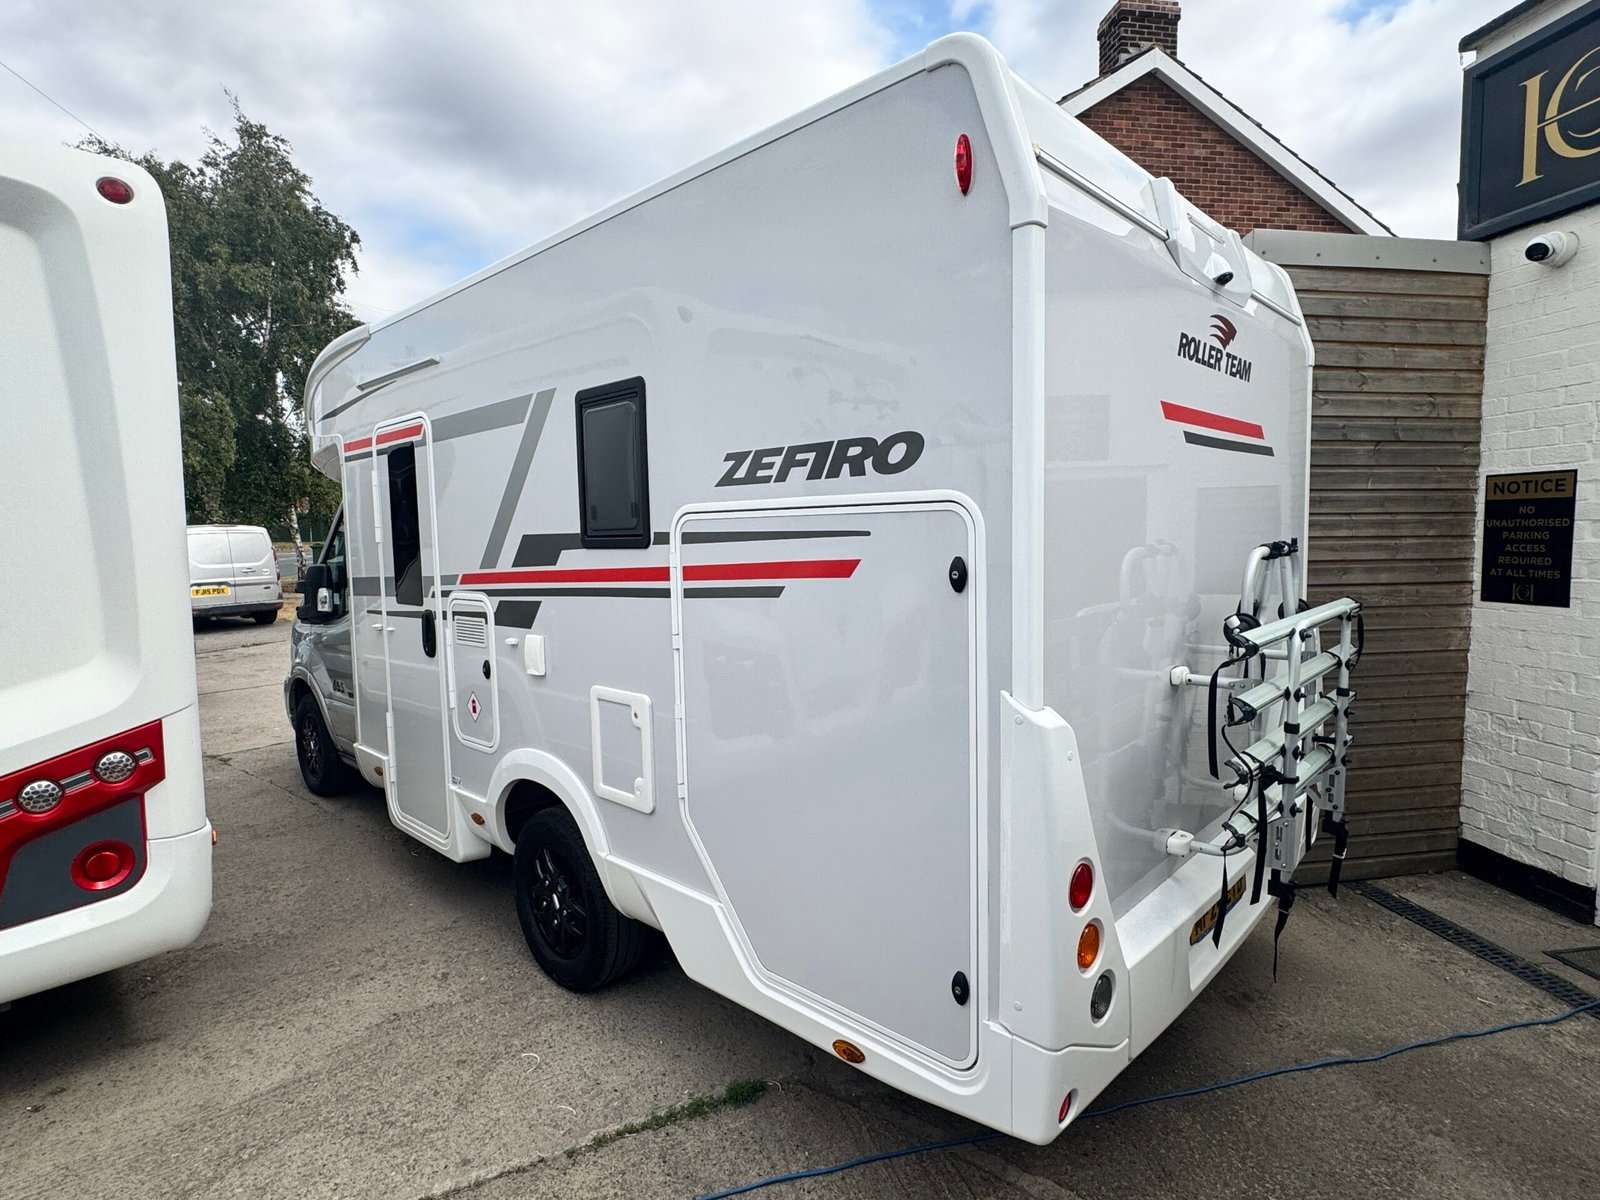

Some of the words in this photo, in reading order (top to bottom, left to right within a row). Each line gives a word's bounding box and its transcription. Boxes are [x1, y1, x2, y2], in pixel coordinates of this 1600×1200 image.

[1177, 331, 1224, 372] ROLLER
[1224, 351, 1252, 383] TEAM
[713, 430, 926, 488] ZEFIRO
[1493, 478, 1567, 495] NOTICE
[1519, 505, 1536, 514] NO
[1486, 518, 1570, 528] UNAUTHORISED
[1502, 531, 1550, 540] PARKING
[1504, 543, 1547, 553] ACCESS
[1497, 556, 1553, 566] REQUIRED
[1489, 568, 1504, 576] AT
[1505, 568, 1527, 578] ALL
[1528, 569, 1561, 580] TIMES
